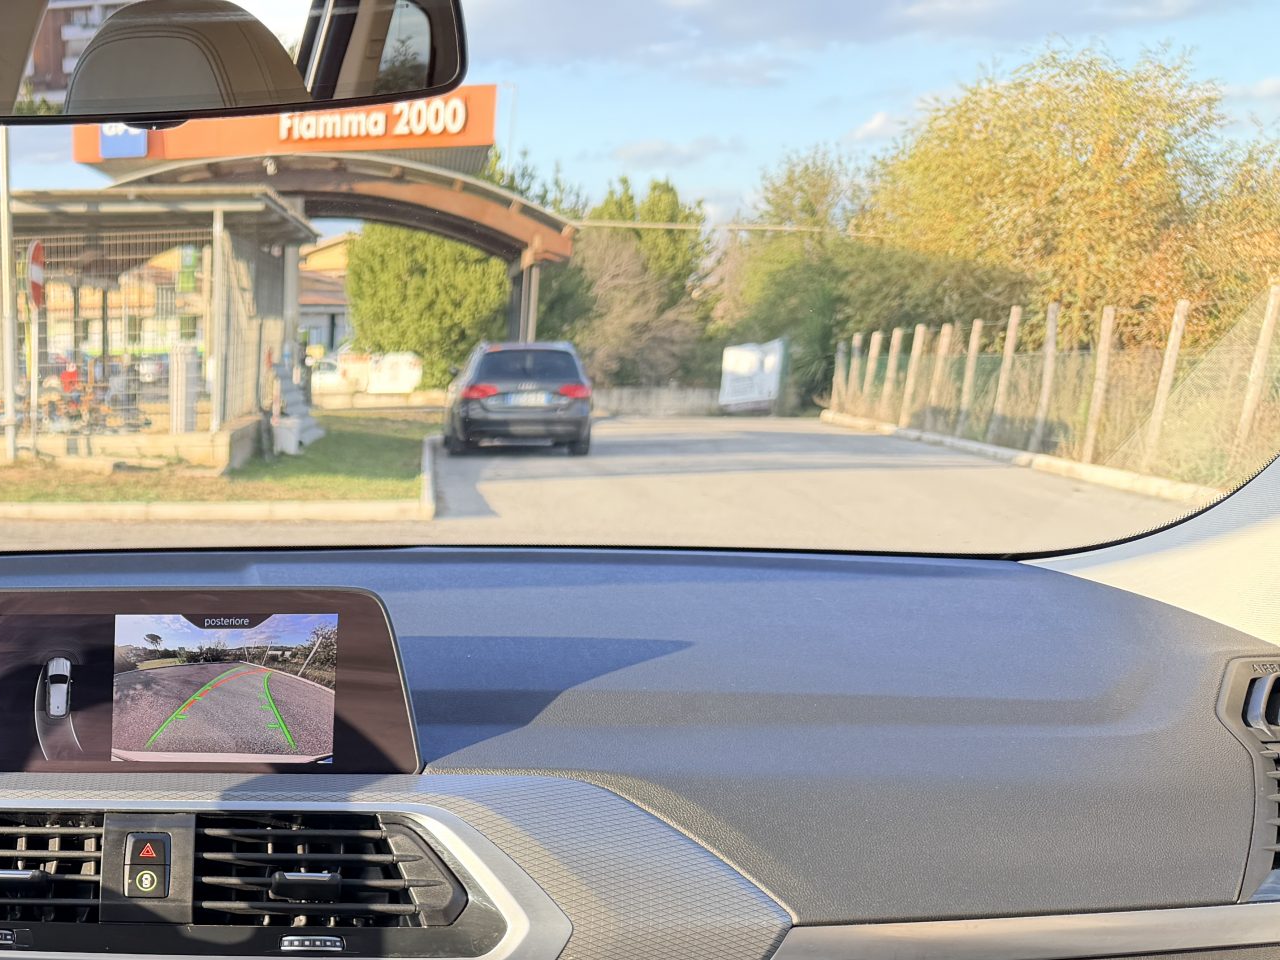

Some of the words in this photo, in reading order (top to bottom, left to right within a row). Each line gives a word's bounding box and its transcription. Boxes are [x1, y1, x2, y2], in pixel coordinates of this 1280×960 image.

[279, 111, 387, 140] Fiamma
[393, 98, 466, 135] 2000
[204, 616, 250, 628] posteriore
